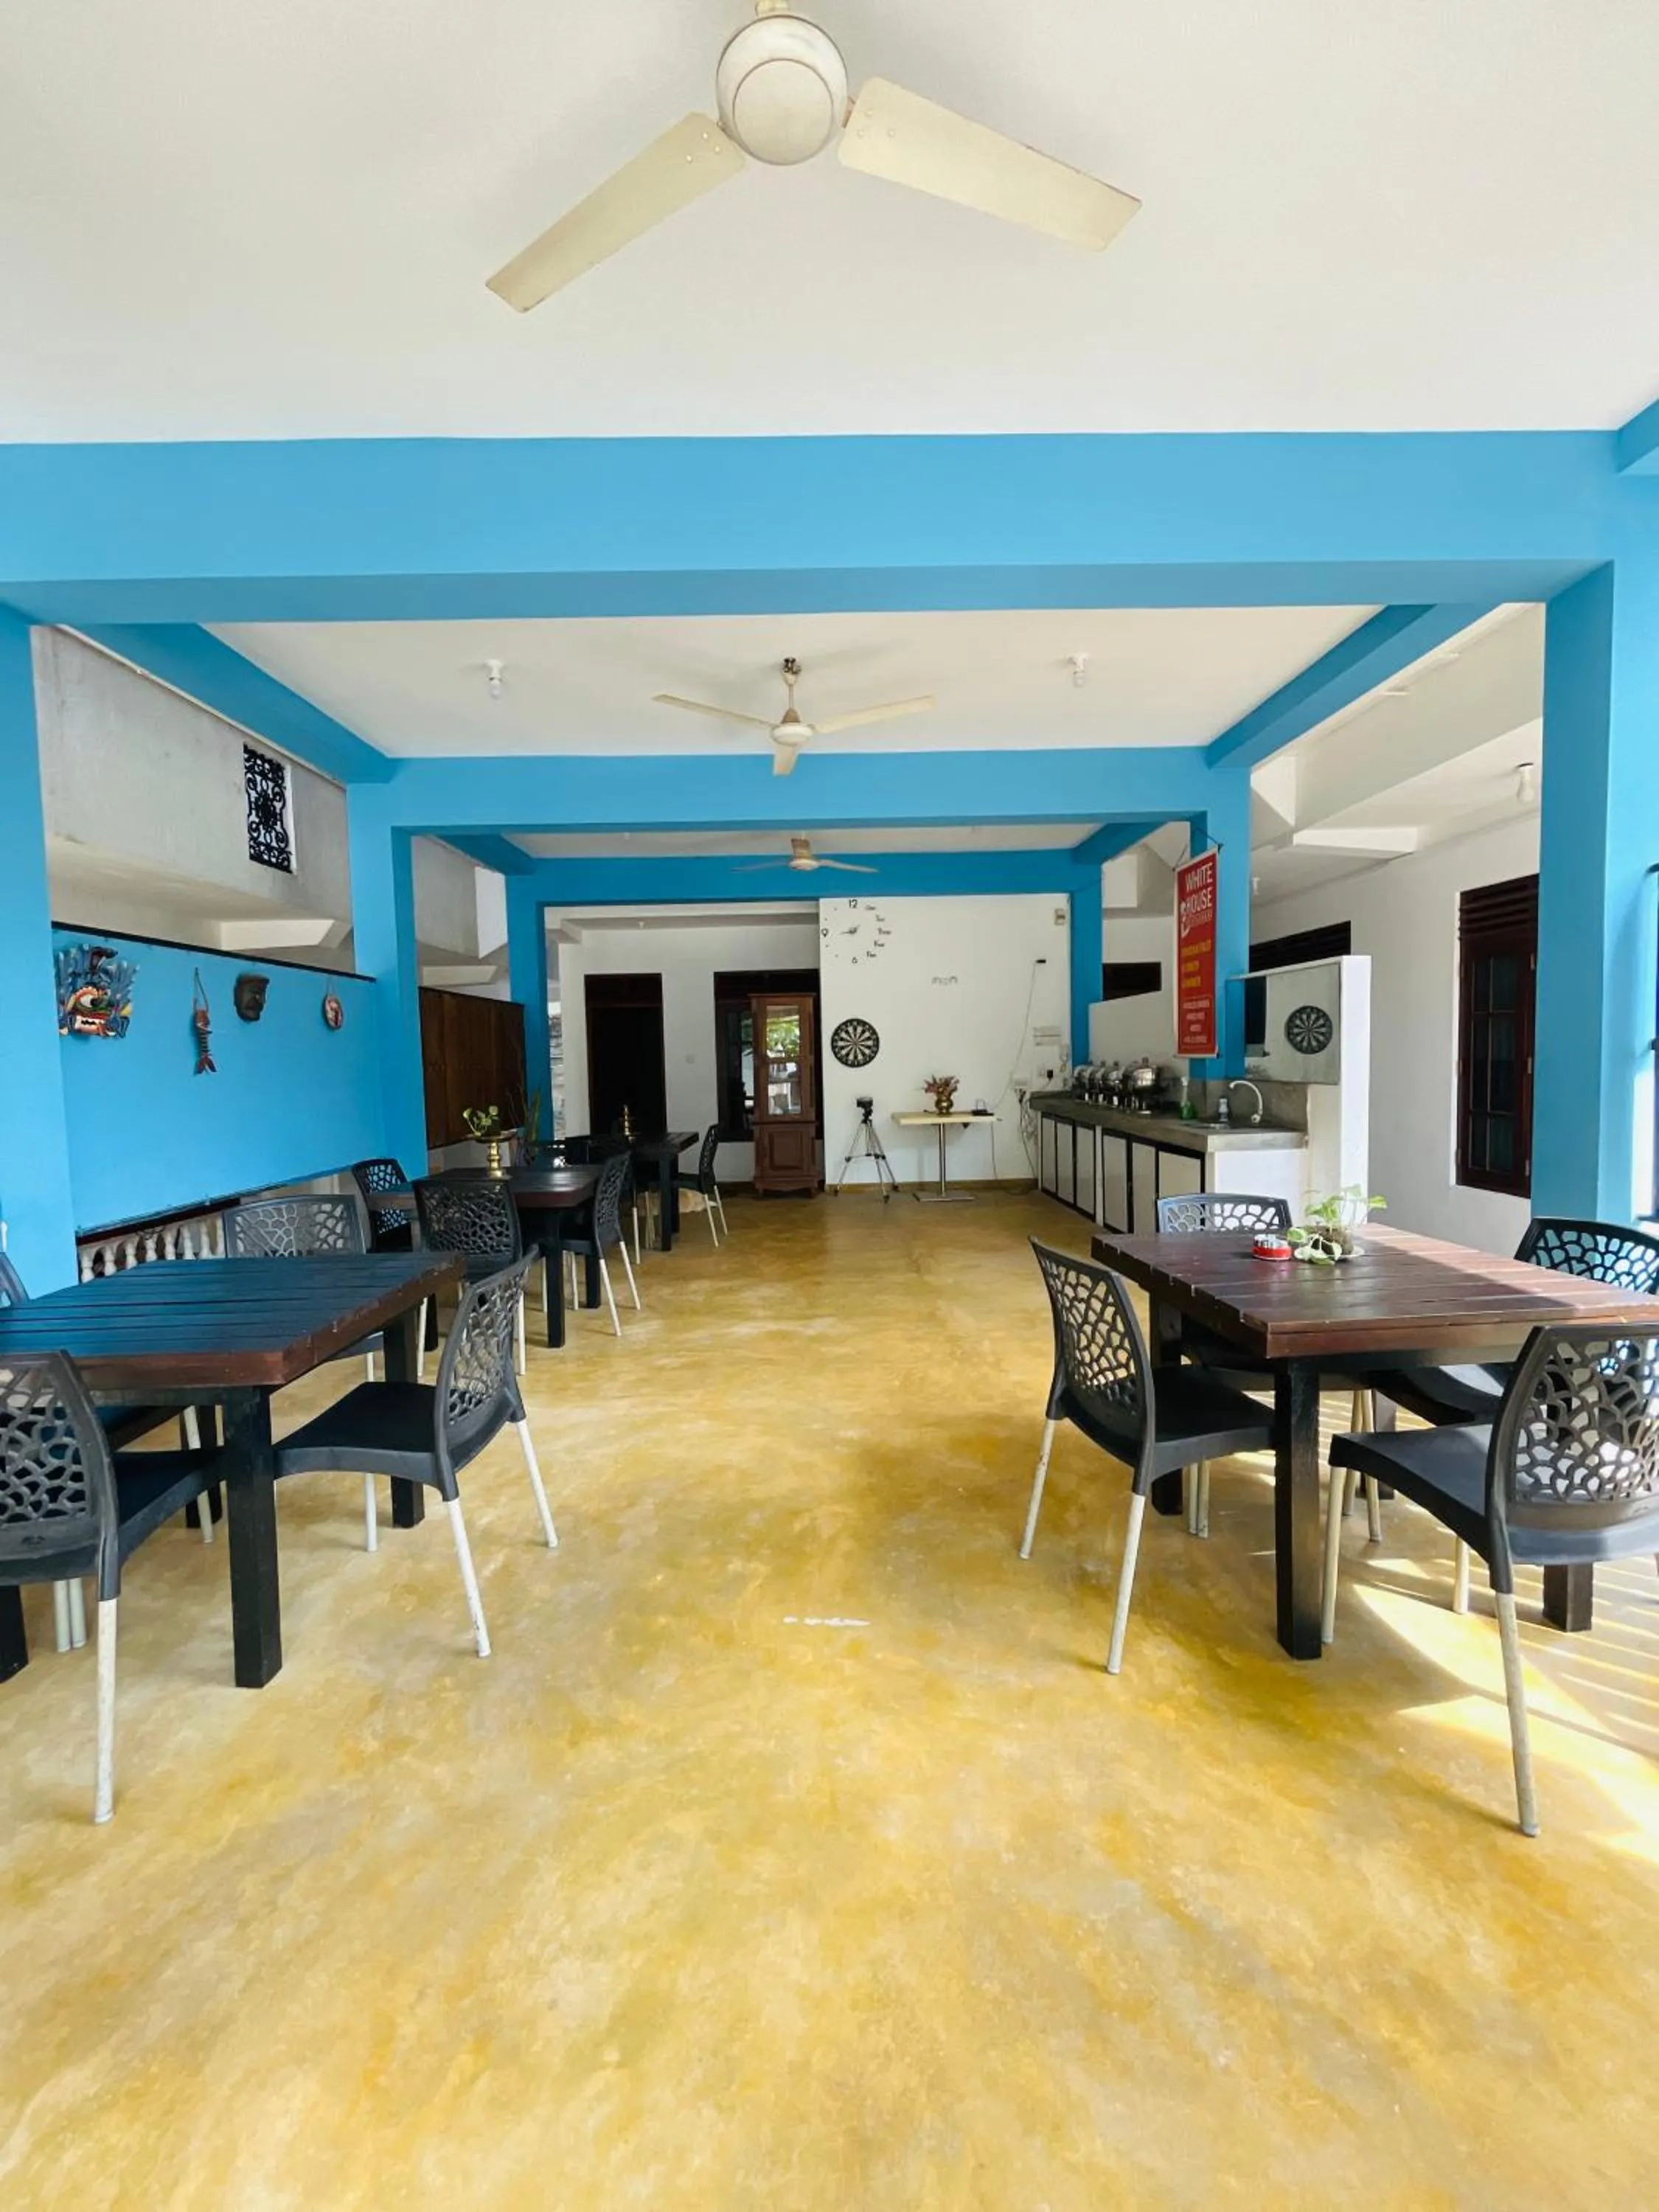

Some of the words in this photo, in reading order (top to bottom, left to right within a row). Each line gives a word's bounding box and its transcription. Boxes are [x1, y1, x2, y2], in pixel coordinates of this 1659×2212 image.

[1186, 862, 1213, 893] WHITE
[849, 899, 858, 908] 12
[1186, 886, 1213, 913] HOUSE
